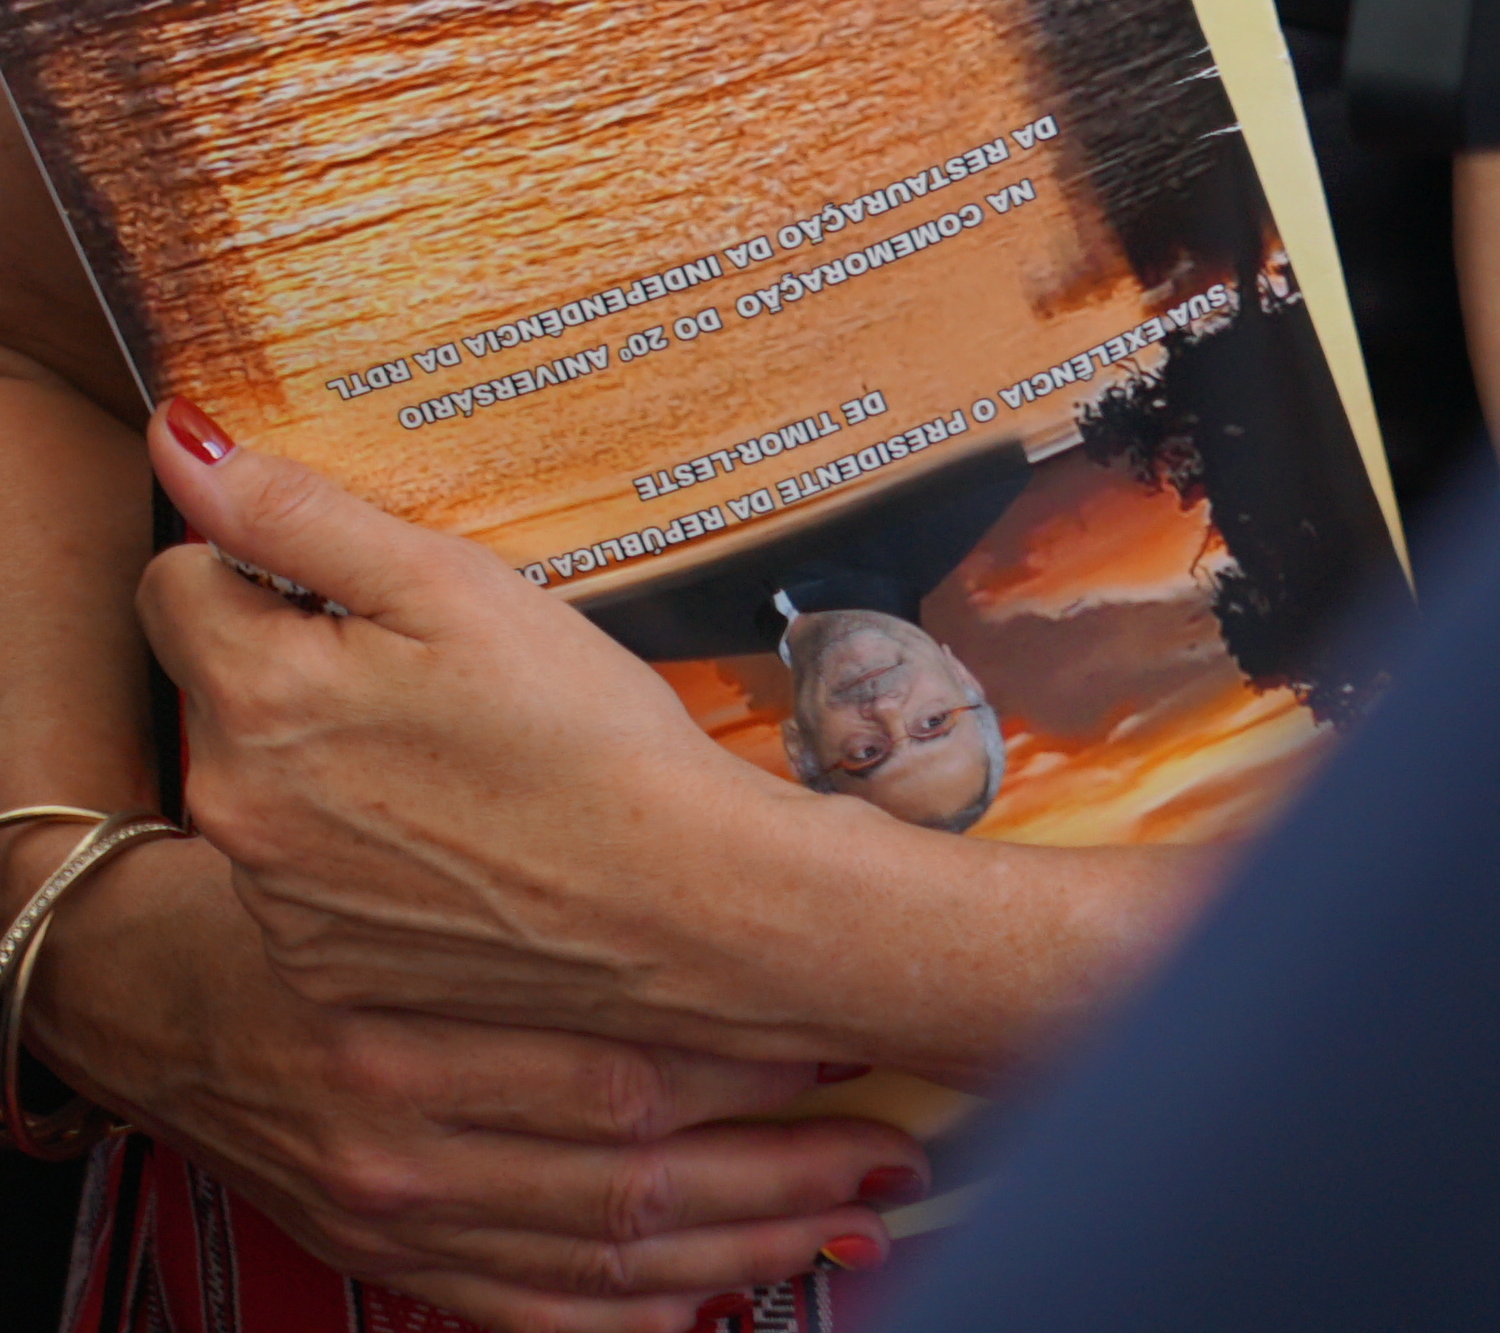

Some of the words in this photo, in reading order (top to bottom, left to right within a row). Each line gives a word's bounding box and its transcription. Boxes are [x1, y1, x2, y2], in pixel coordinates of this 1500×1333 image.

[1011, 114, 1060, 149] DA
[777, 137, 1011, 250] RESTAURAÇÃO
[985, 178, 1036, 214] NA
[723, 235, 774, 269] DA
[735, 203, 984, 319] COMEMORAÇÃO
[462, 254, 723, 358] INDEPENDÊNCIA
[673, 307, 723, 341] DO
[1166, 283, 1229, 328] SUA
[326, 358, 412, 401] RDTL
[414, 342, 462, 373] DA
[998, 316, 1168, 410] EXELÊNCIA
[398, 344, 610, 430] ANIVERSÁRIO
[840, 390, 888, 426] DE
[971, 398, 998, 423] O
[632, 411, 841, 501] TIMOR-LESTE
[775, 408, 968, 505] PRESIDENTE
[726, 488, 775, 521] DA
[548, 505, 727, 579] REPÚBLICA
